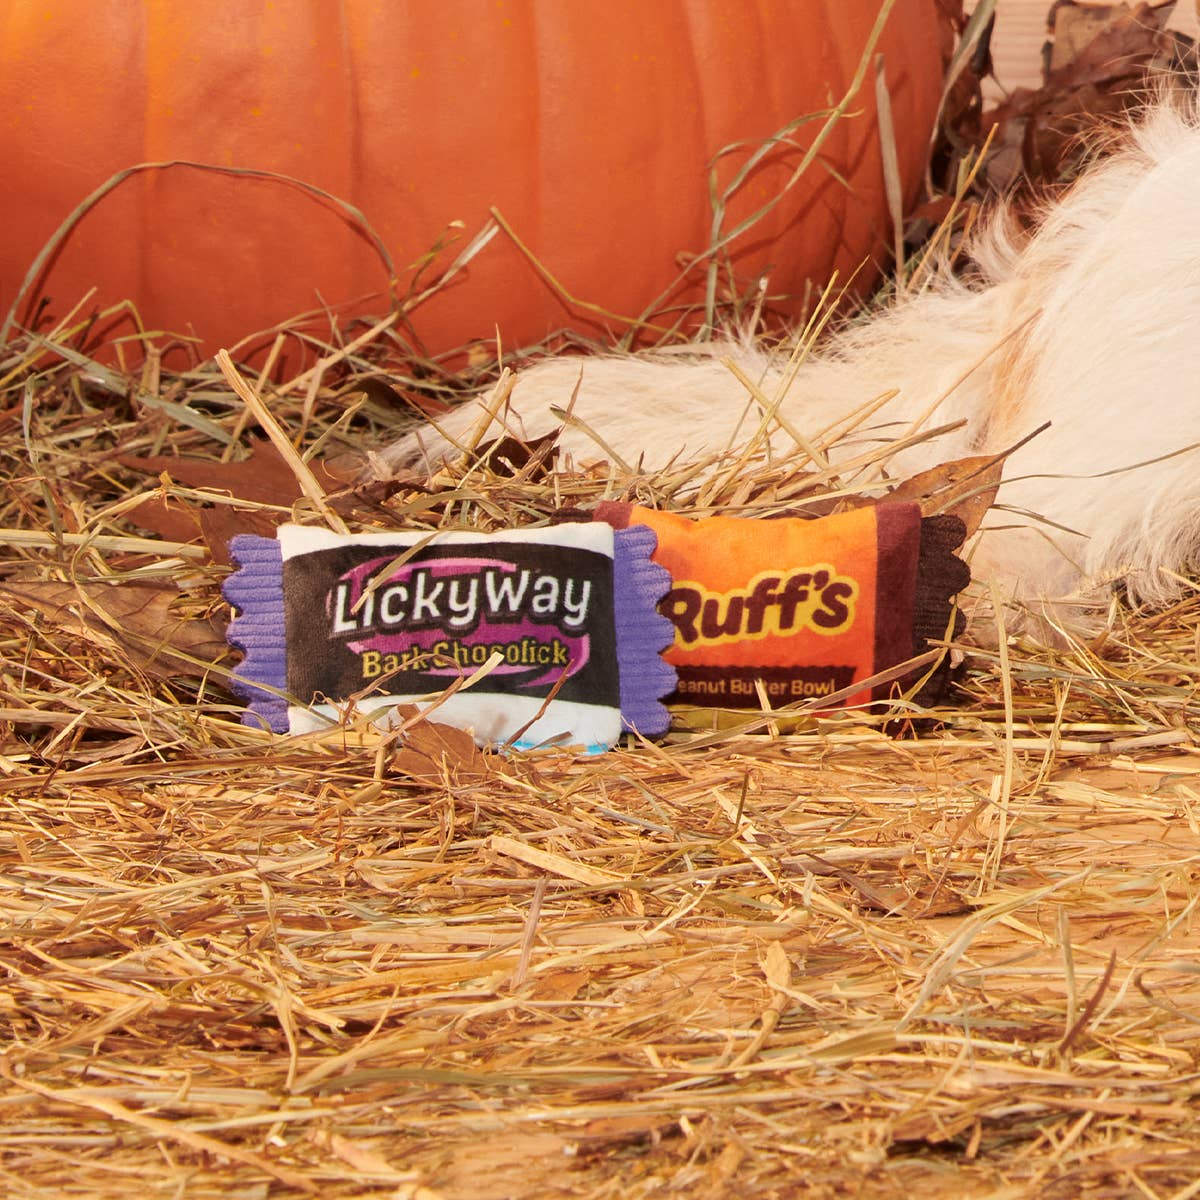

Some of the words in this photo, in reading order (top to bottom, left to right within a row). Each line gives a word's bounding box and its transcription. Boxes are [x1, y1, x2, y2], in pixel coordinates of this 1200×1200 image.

[333, 570, 592, 633] LickyWay
[657, 570, 853, 643] Ruff's
[678, 678, 726, 694] eanut
[730, 678, 787, 695] Buer
[791, 678, 835, 695] Bowl
